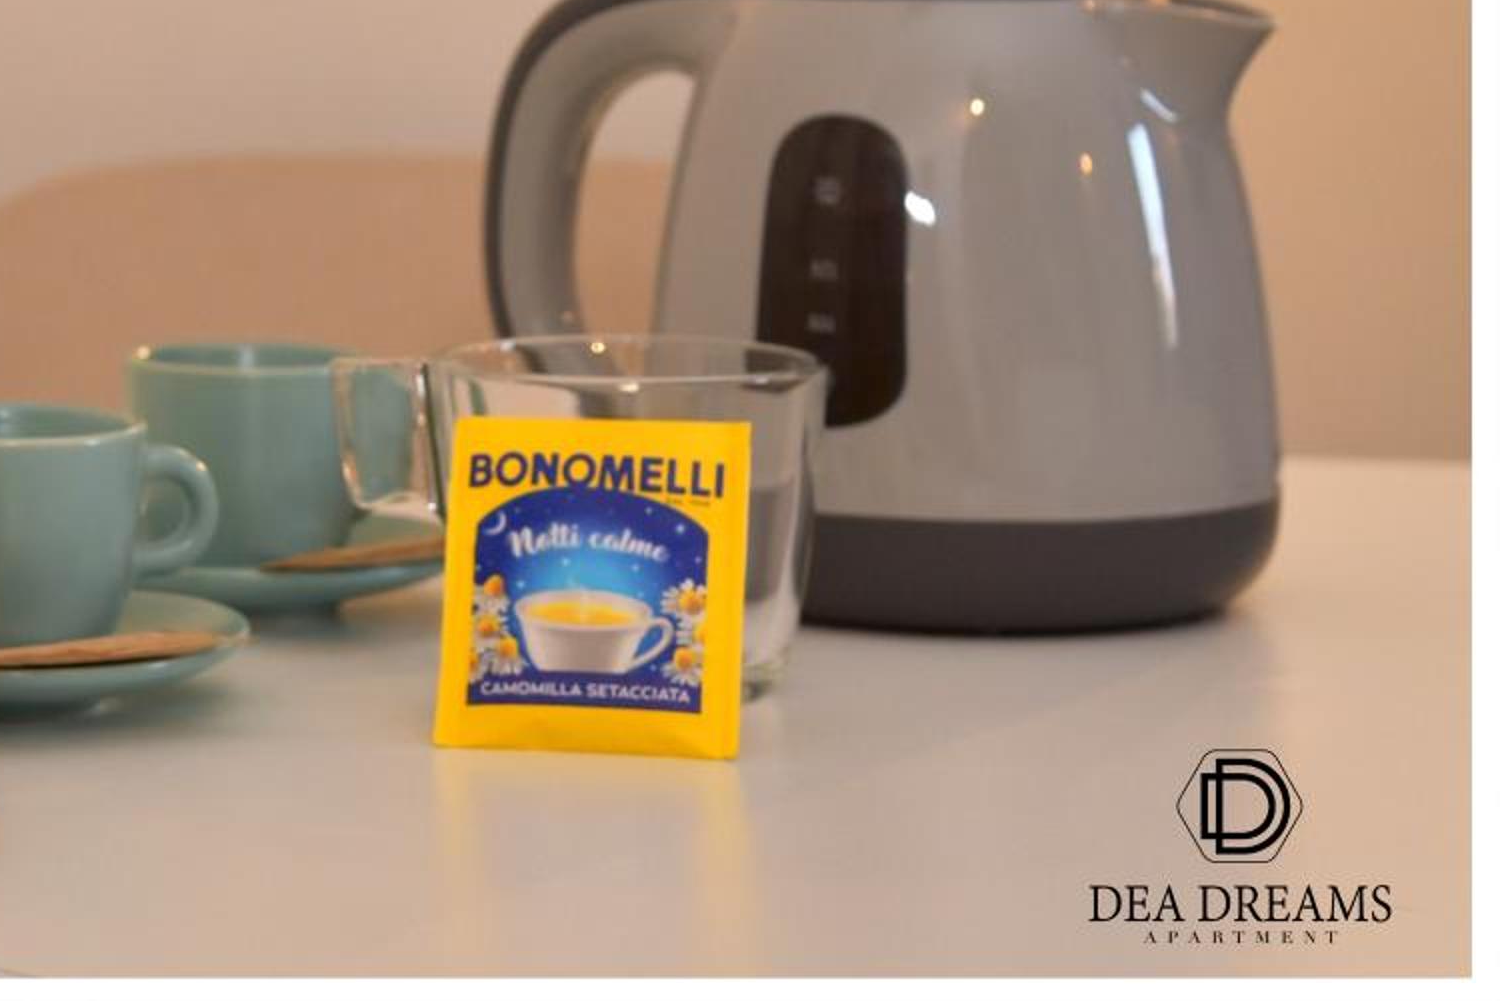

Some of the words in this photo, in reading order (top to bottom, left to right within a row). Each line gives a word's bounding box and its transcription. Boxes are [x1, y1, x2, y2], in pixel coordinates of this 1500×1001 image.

[469, 451, 725, 499] BONOMELLI
[507, 521, 581, 559] Notti
[588, 528, 670, 563] calme
[480, 680, 582, 697] CAMOMILLA
[586, 682, 690, 704] SETACCIATA
